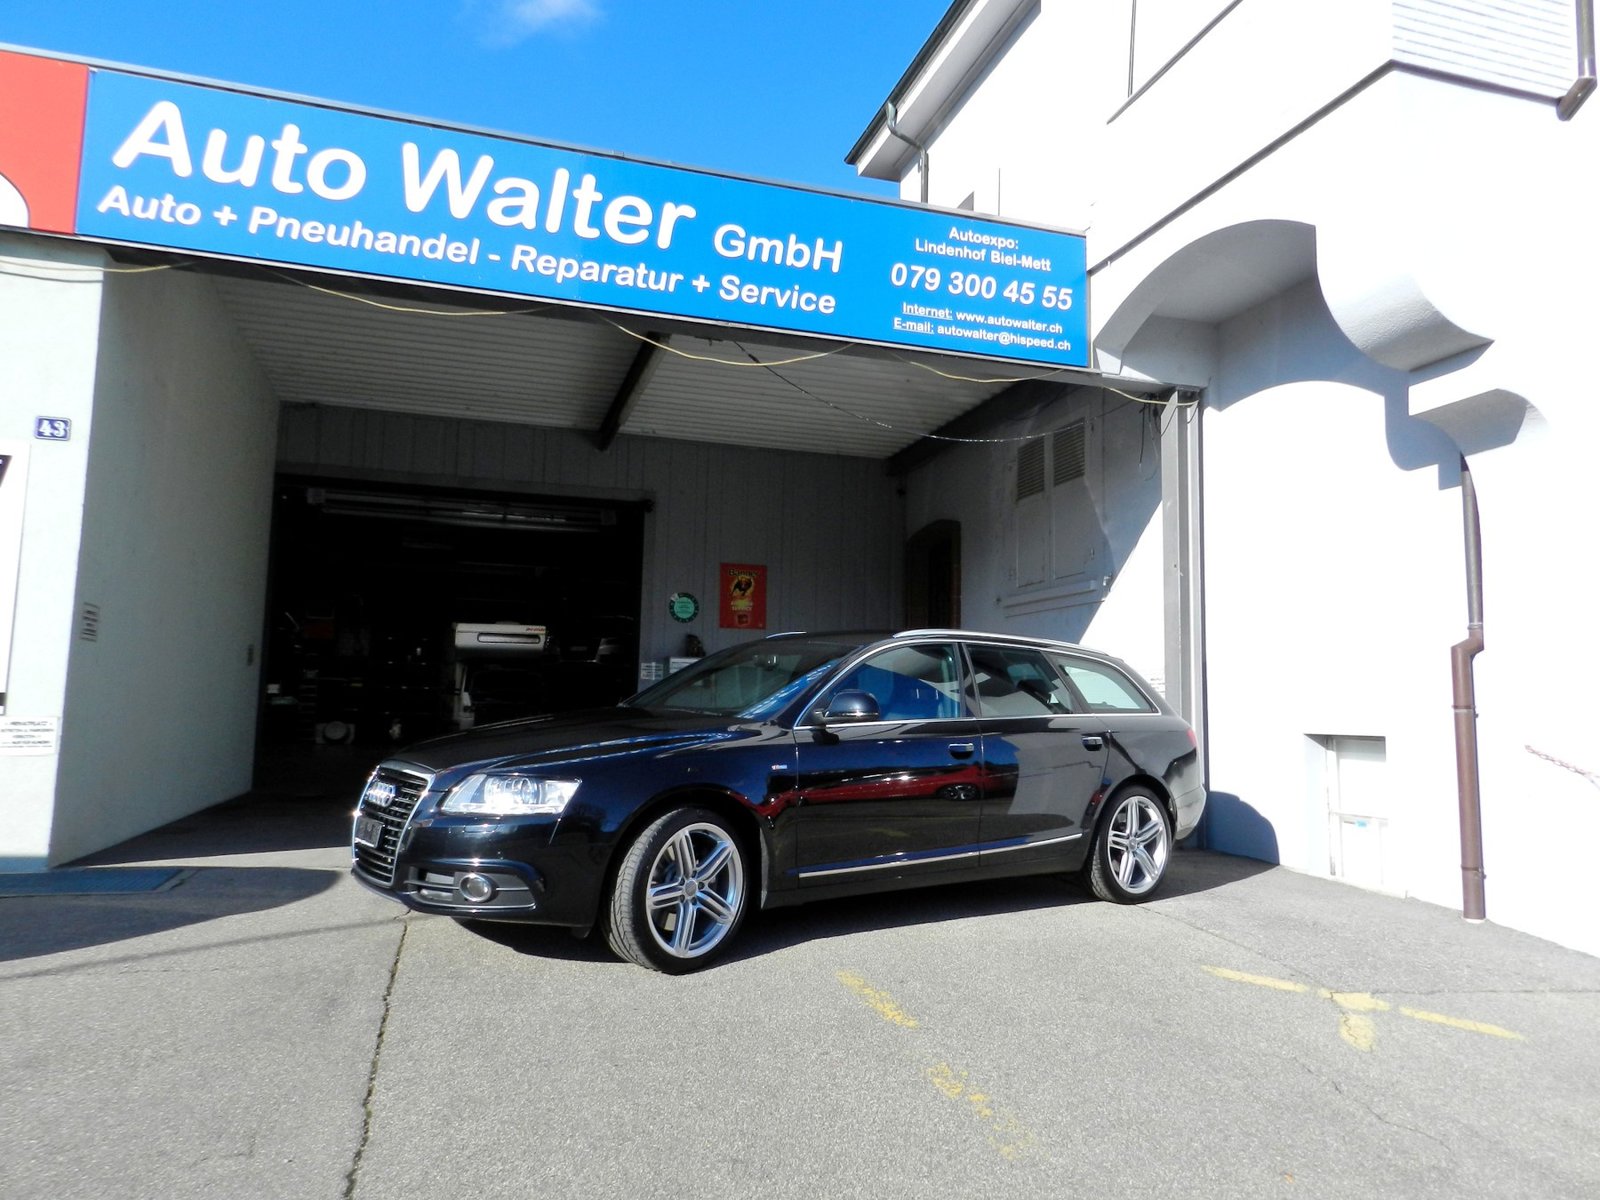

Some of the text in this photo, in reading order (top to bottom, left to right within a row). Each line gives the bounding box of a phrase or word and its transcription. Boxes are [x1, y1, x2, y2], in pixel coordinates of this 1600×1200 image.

[111, 99, 843, 273] Auto Walter GmbH
[96, 184, 202, 226] Auto
[212, 205, 238, 227] +
[248, 204, 481, 265] Pneuhandel
[510, 244, 684, 293] Reparatur
[691, 274, 711, 293] +
[719, 274, 836, 314] Service
[915, 238, 1052, 272] Lindenhof Biel-Mett
[948, 226, 1020, 250] Autoexpo:
[890, 262, 1073, 311] 079 300 45 55
[893, 317, 1071, 351] E-mail: autowalter@hispeed.ch
[902, 302, 1063, 334] Internet: www.autowalter.ch
[39, 419, 66, 438] 43
